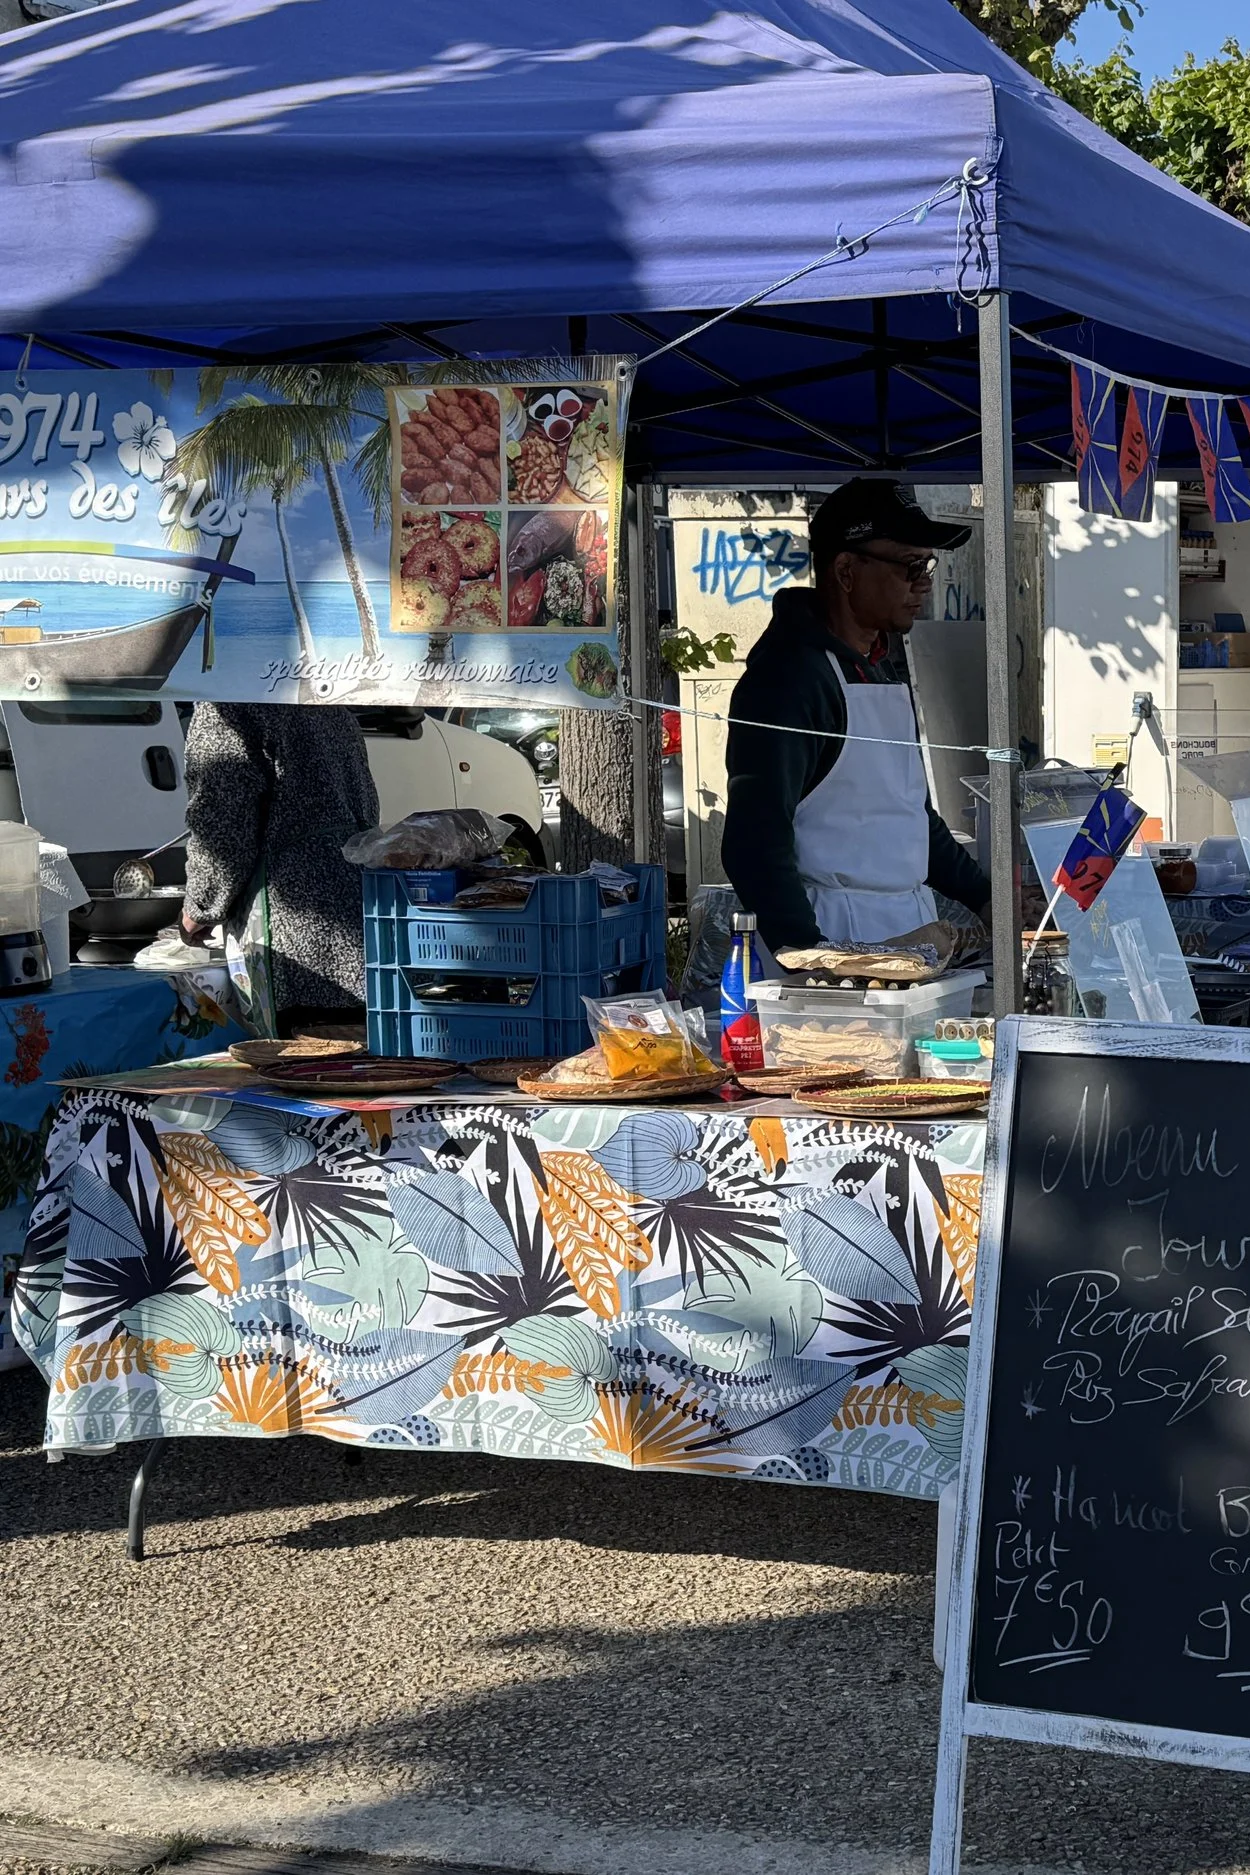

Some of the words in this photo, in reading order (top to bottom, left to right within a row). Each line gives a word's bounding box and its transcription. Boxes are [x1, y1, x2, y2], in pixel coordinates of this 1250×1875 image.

[1126, 431, 1143, 475] 974
[69, 460, 139, 521] des
[158, 472, 247, 537] îles
[34, 565, 69, 580] vos
[259, 650, 393, 692] spécialités
[401, 655, 559, 684] réunionnaise
[1040, 1084, 1239, 1193] Menu
[1047, 1269, 1206, 1377] Rougail
[1042, 1350, 1115, 1424] Riz
[994, 1521, 1070, 1569] Petit
